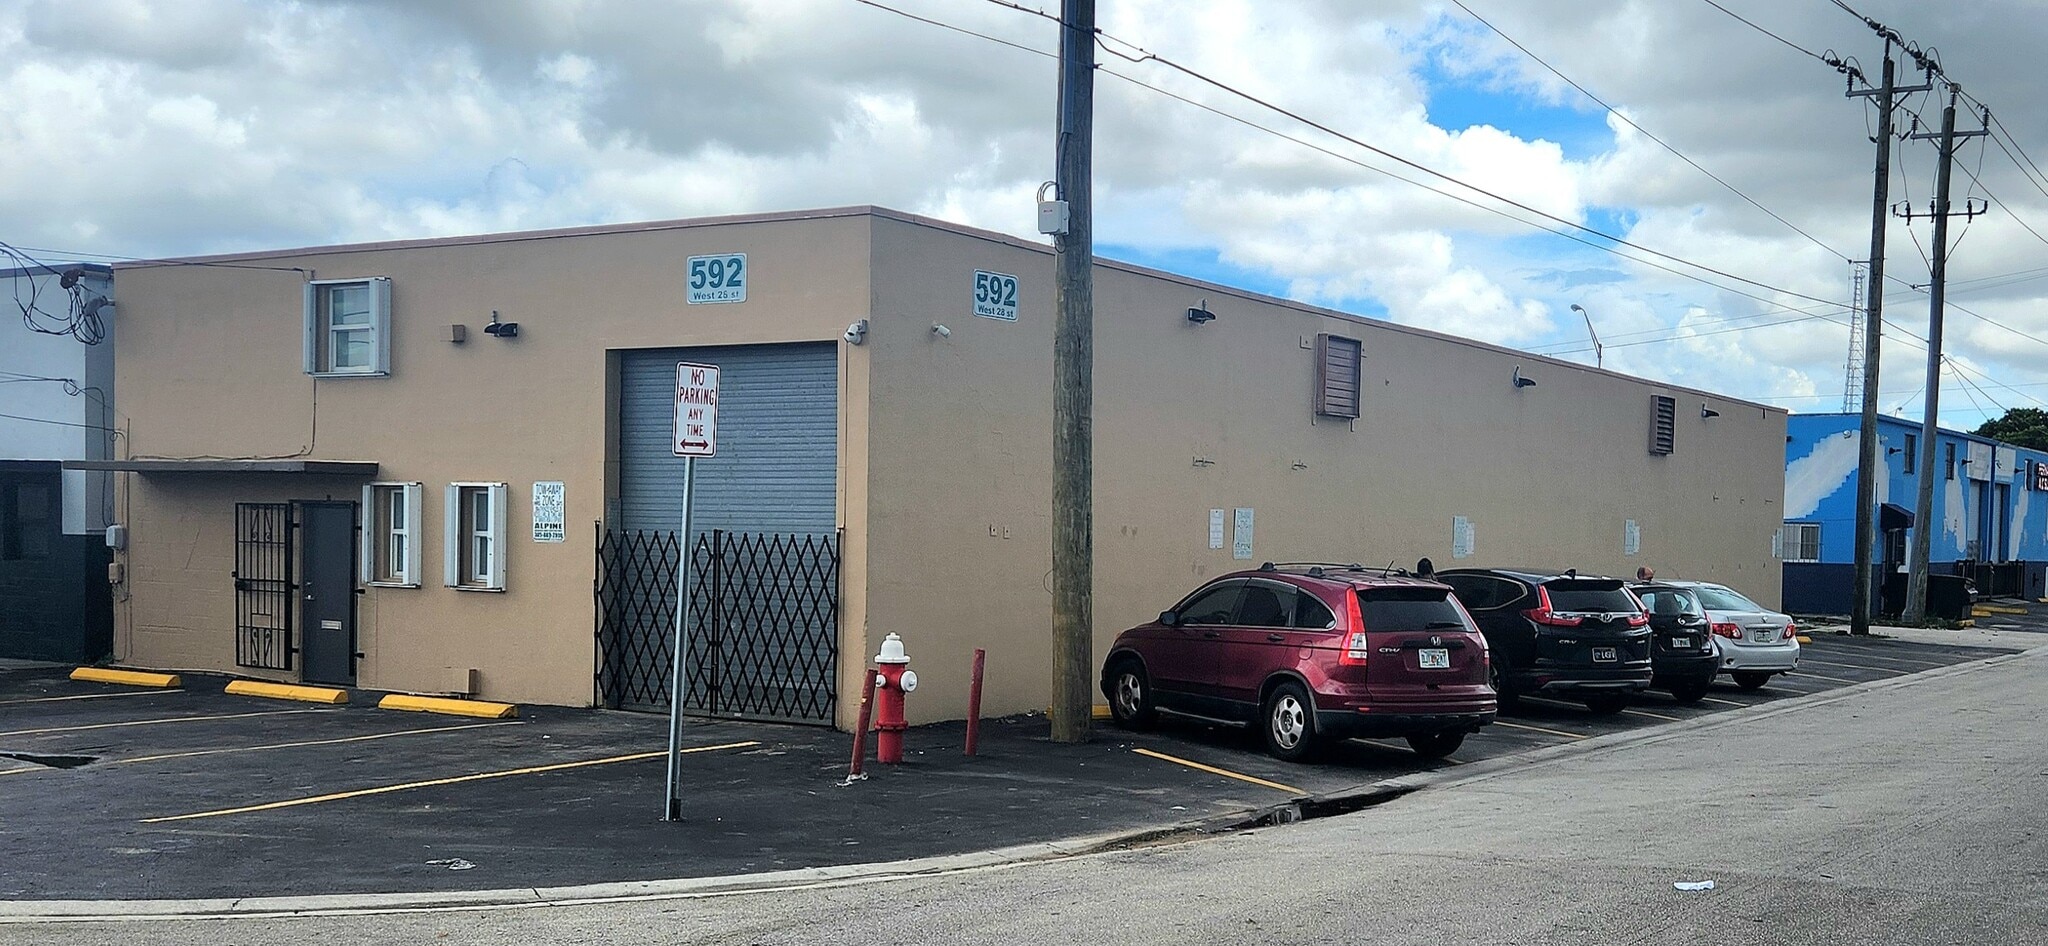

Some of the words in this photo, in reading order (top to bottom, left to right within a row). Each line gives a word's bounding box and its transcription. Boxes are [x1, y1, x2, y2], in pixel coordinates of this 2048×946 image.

[690, 257, 743, 290] 592
[693, 291, 715, 300] West
[730, 291, 739, 299] st
[975, 273, 1016, 307] 592
[977, 304, 995, 315] West
[1006, 310, 1014, 318] st
[690, 368, 705, 386] NO
[679, 386, 715, 406] PARKING
[687, 408, 704, 421] ANY
[686, 423, 704, 437] TIME
